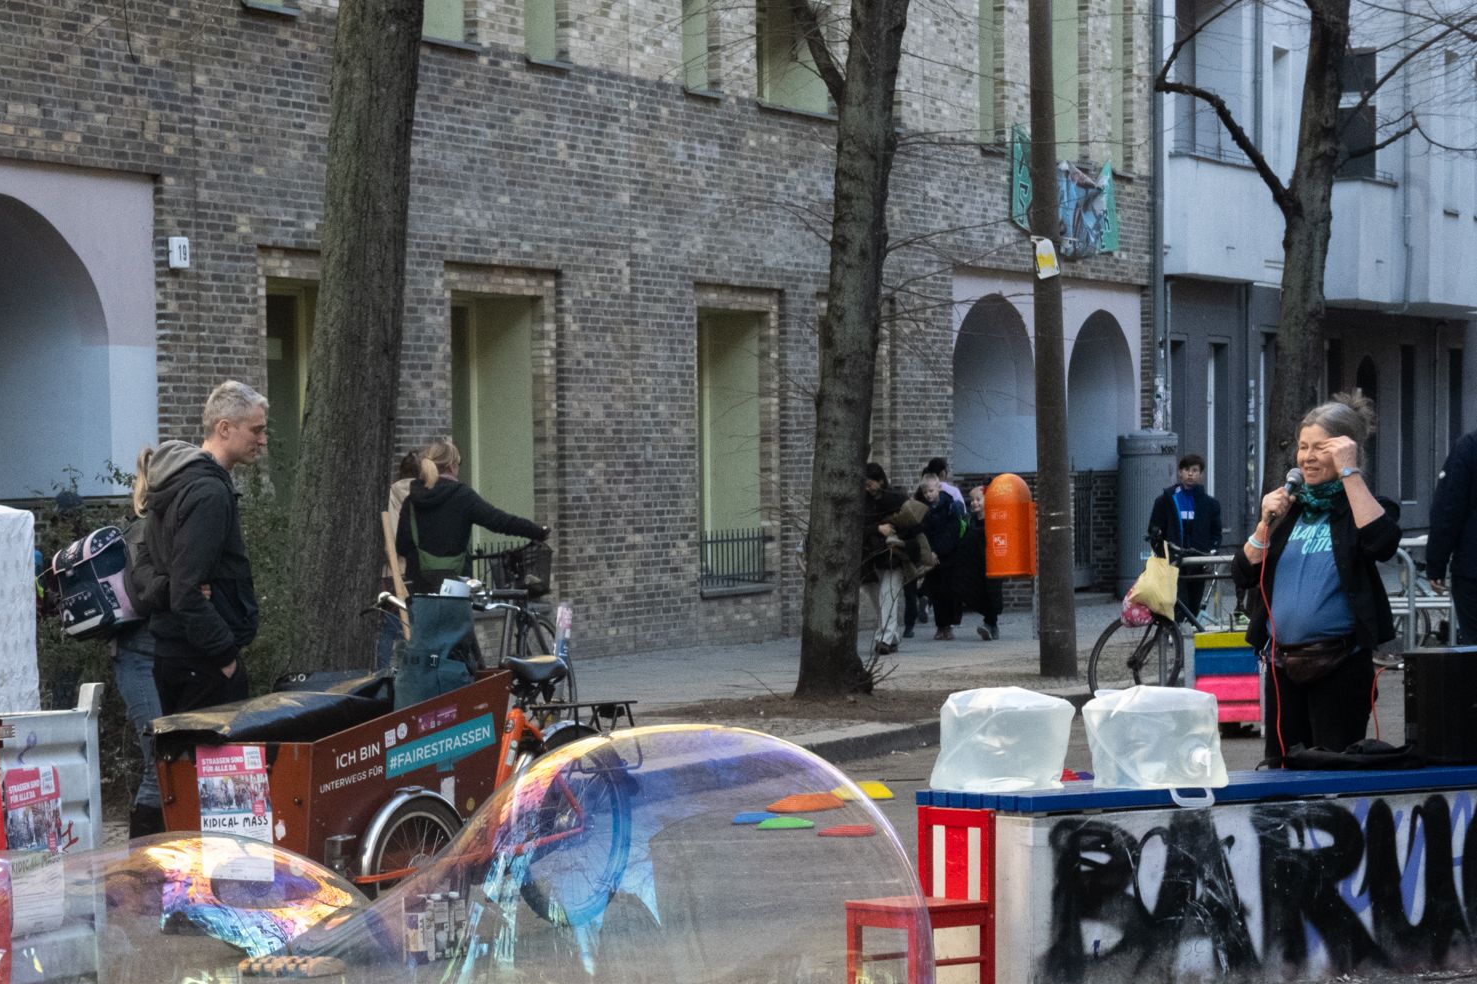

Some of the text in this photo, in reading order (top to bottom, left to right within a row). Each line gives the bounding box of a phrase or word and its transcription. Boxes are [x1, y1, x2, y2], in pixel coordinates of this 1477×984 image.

[178, 244, 187, 262] 19
[202, 757, 231, 766] STRASSEN
[319, 771, 368, 794] UNTERWEGS
[368, 765, 384, 778] FÜR
[389, 724, 491, 770] #FAIRESTRASSEN
[335, 742, 381, 769] ICH BIN
[215, 764, 227, 772] ALLE
[228, 763, 237, 771] DA
[203, 815, 268, 828] KIDICAL MASS
